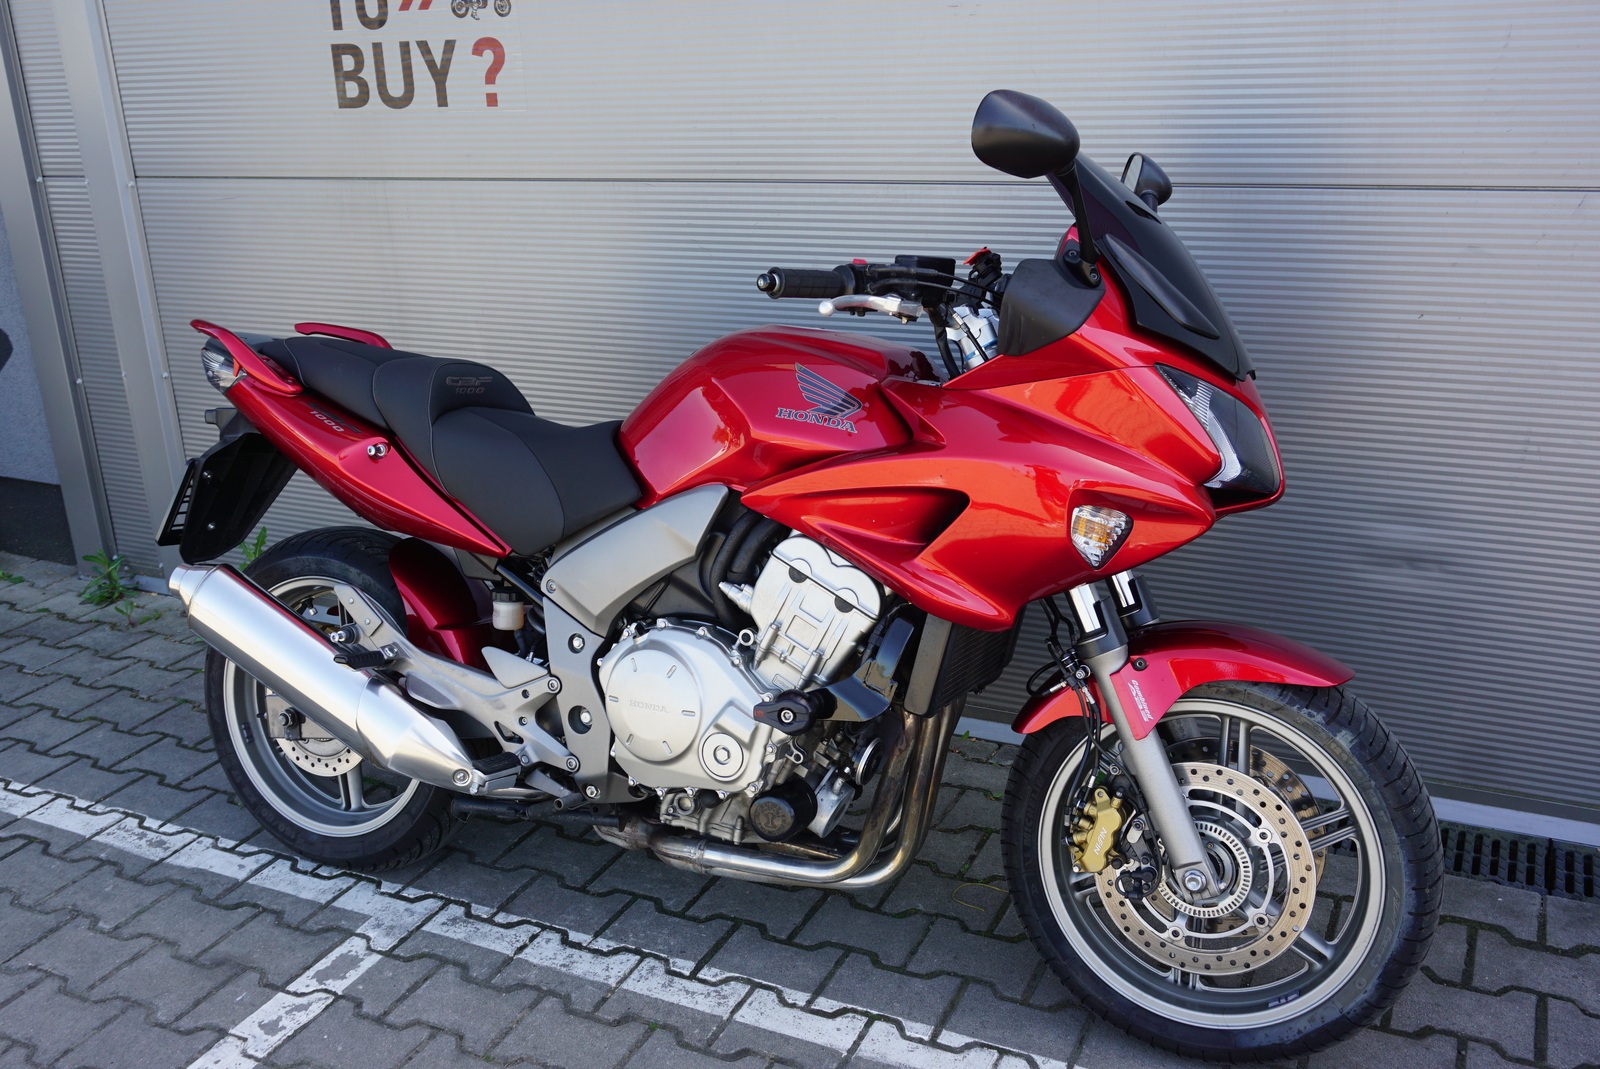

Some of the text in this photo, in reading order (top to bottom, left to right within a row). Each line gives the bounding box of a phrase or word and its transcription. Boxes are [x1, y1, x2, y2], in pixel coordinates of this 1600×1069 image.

[330, 36, 506, 109] BUY ?
[310, 410, 345, 432] 1000
[775, 407, 857, 434] HONDA
[629, 699, 670, 714] HONDA
